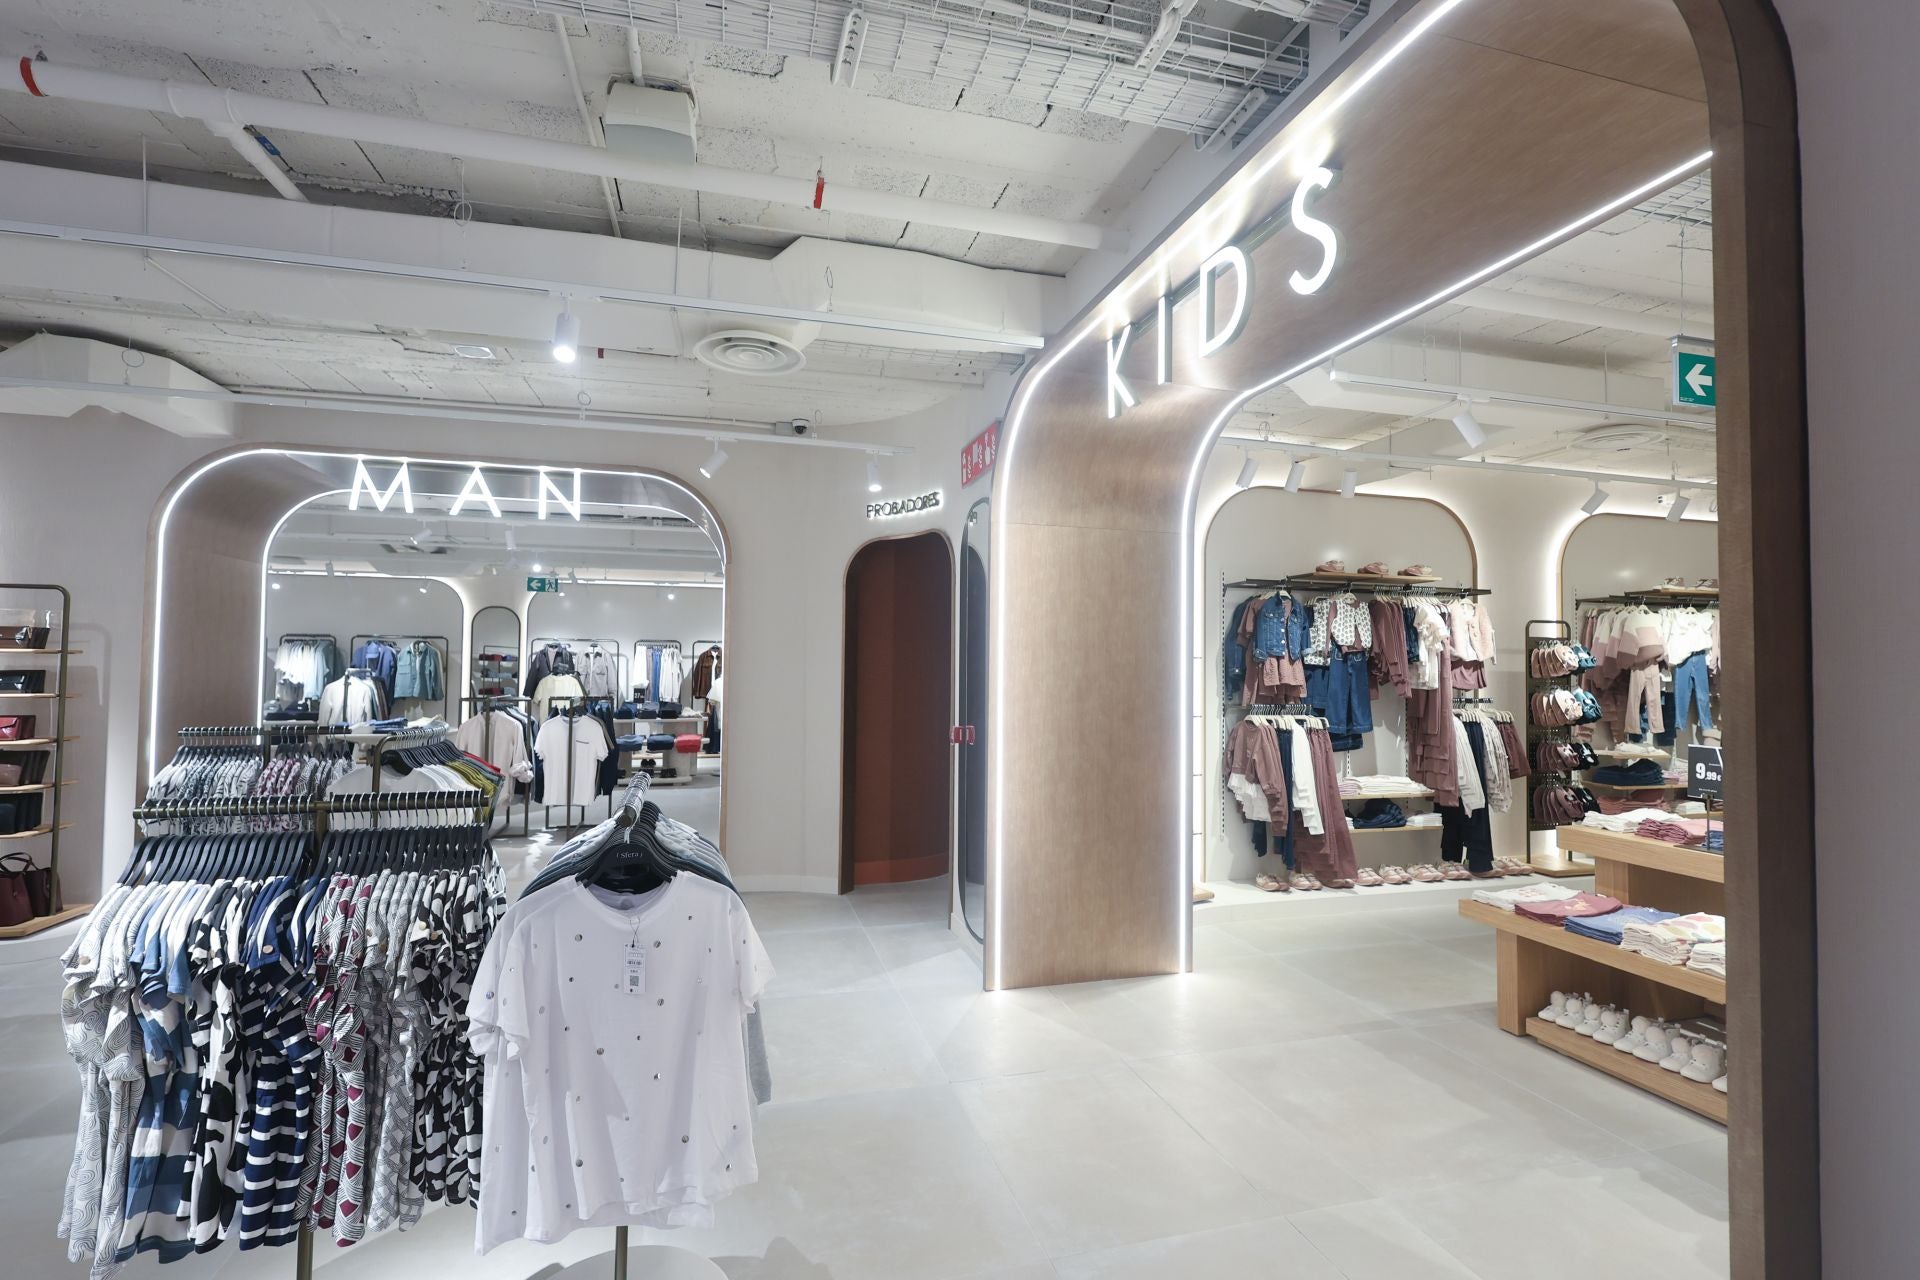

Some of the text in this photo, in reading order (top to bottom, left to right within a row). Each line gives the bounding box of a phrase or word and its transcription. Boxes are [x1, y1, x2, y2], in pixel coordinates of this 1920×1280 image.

[1107, 166, 1341, 419] KIDS
[348, 456, 581, 521] MAN
[866, 490, 942, 519] PROBADORES
